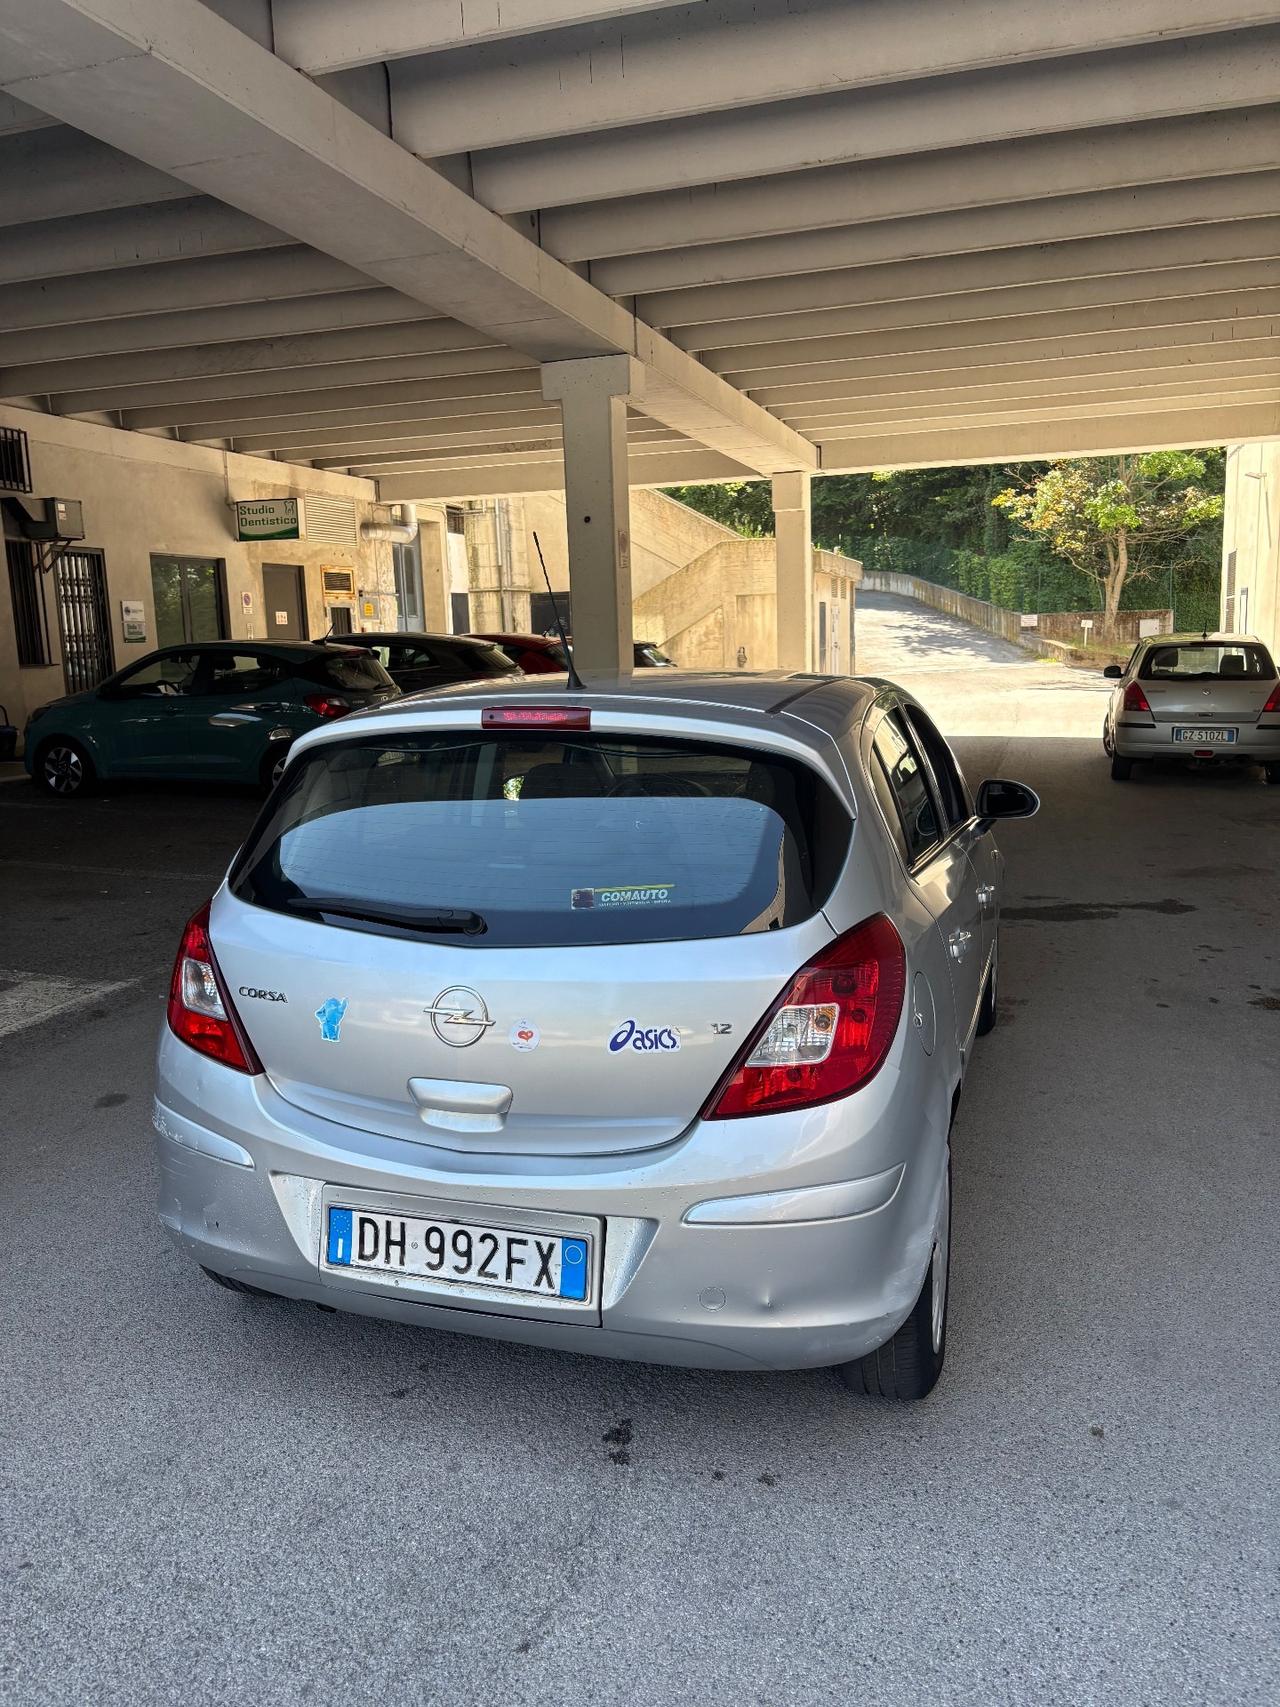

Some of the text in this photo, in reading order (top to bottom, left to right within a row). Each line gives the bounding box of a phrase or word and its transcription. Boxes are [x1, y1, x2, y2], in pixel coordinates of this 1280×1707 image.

[239, 505, 275, 515] Studio
[240, 517, 297, 526] Dentistico
[1183, 731, 1194, 741] GZ
[601, 889, 668, 902] COMAUTO
[239, 986, 288, 1003] CORSA
[358, 1216, 556, 1290] DH 992FX
